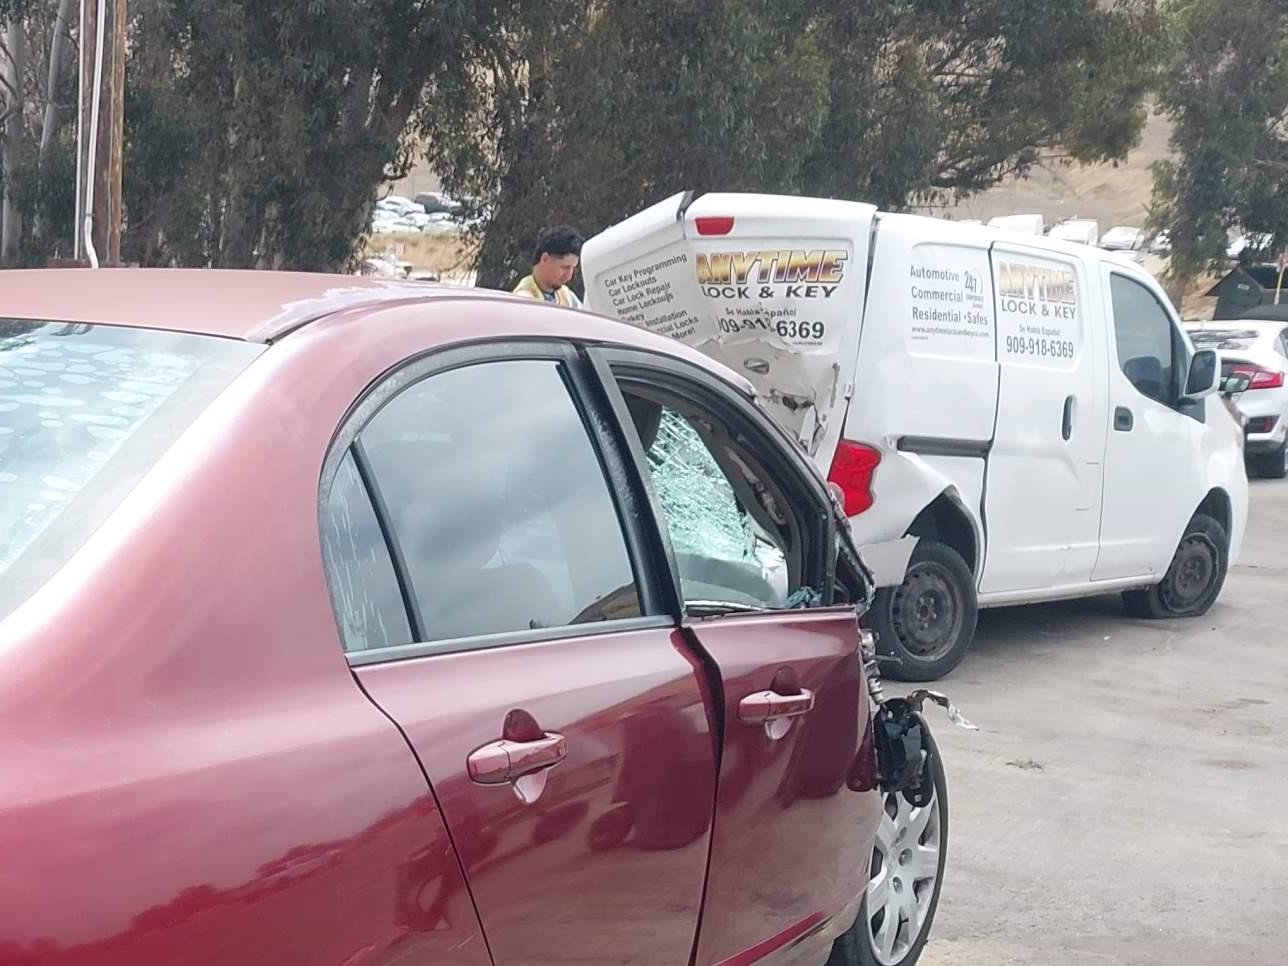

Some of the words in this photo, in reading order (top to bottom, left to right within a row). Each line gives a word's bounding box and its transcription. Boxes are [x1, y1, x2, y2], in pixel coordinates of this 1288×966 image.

[604, 278, 617, 288] Car
[618, 273, 633, 284] Key
[633, 254, 688, 278] Programming
[696, 249, 848, 285] ANYTIME
[910, 264, 960, 282] Automotive
[608, 288, 621, 297] Car
[622, 276, 658, 294] Lockouts
[759, 286, 774, 299] &
[785, 285, 839, 299] KEY
[911, 285, 964, 303] Commercial
[612, 297, 626, 307] Car
[626, 292, 645, 303] Lock
[912, 306, 961, 323] Residential
[1001, 299, 1037, 317] LOCK
[1041, 303, 1050, 317] &
[1055, 305, 1076, 320] KEY
